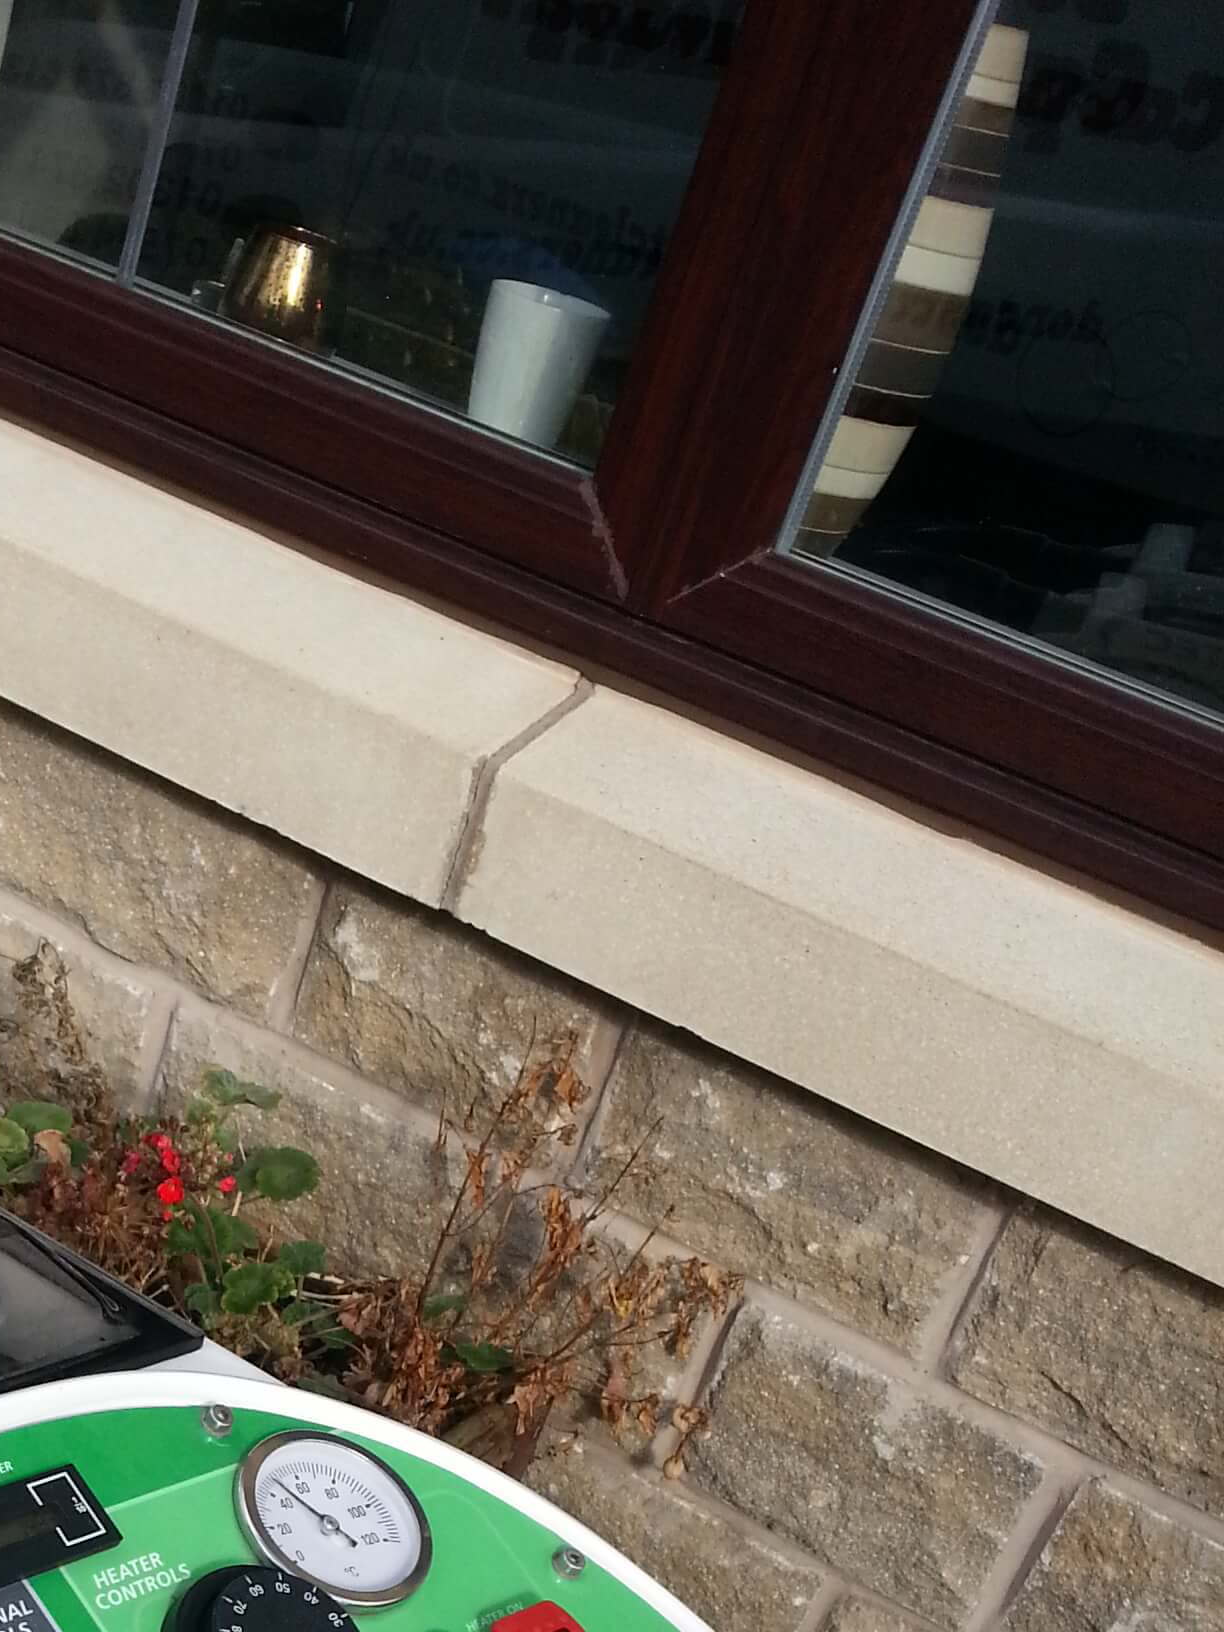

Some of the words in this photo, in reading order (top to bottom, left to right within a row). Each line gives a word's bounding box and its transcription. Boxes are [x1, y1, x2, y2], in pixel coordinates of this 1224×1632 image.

[295, 1481, 311, 1495] 60
[324, 1487, 340, 1500] 80
[279, 1497, 294, 1511] 40
[347, 1505, 367, 1519] 100
[277, 1522, 292, 1535] 20
[360, 1532, 380, 1546] 120
[295, 1550, 305, 1562] 0
[92, 1551, 164, 1590] HEATER
[95, 1563, 192, 1610] CONTROLS
[248, 1584, 265, 1597] 60
[275, 1582, 291, 1594] 50
[303, 1591, 320, 1605] 40
[232, 1600, 248, 1615] 70
[327, 1612, 344, 1628] 30
